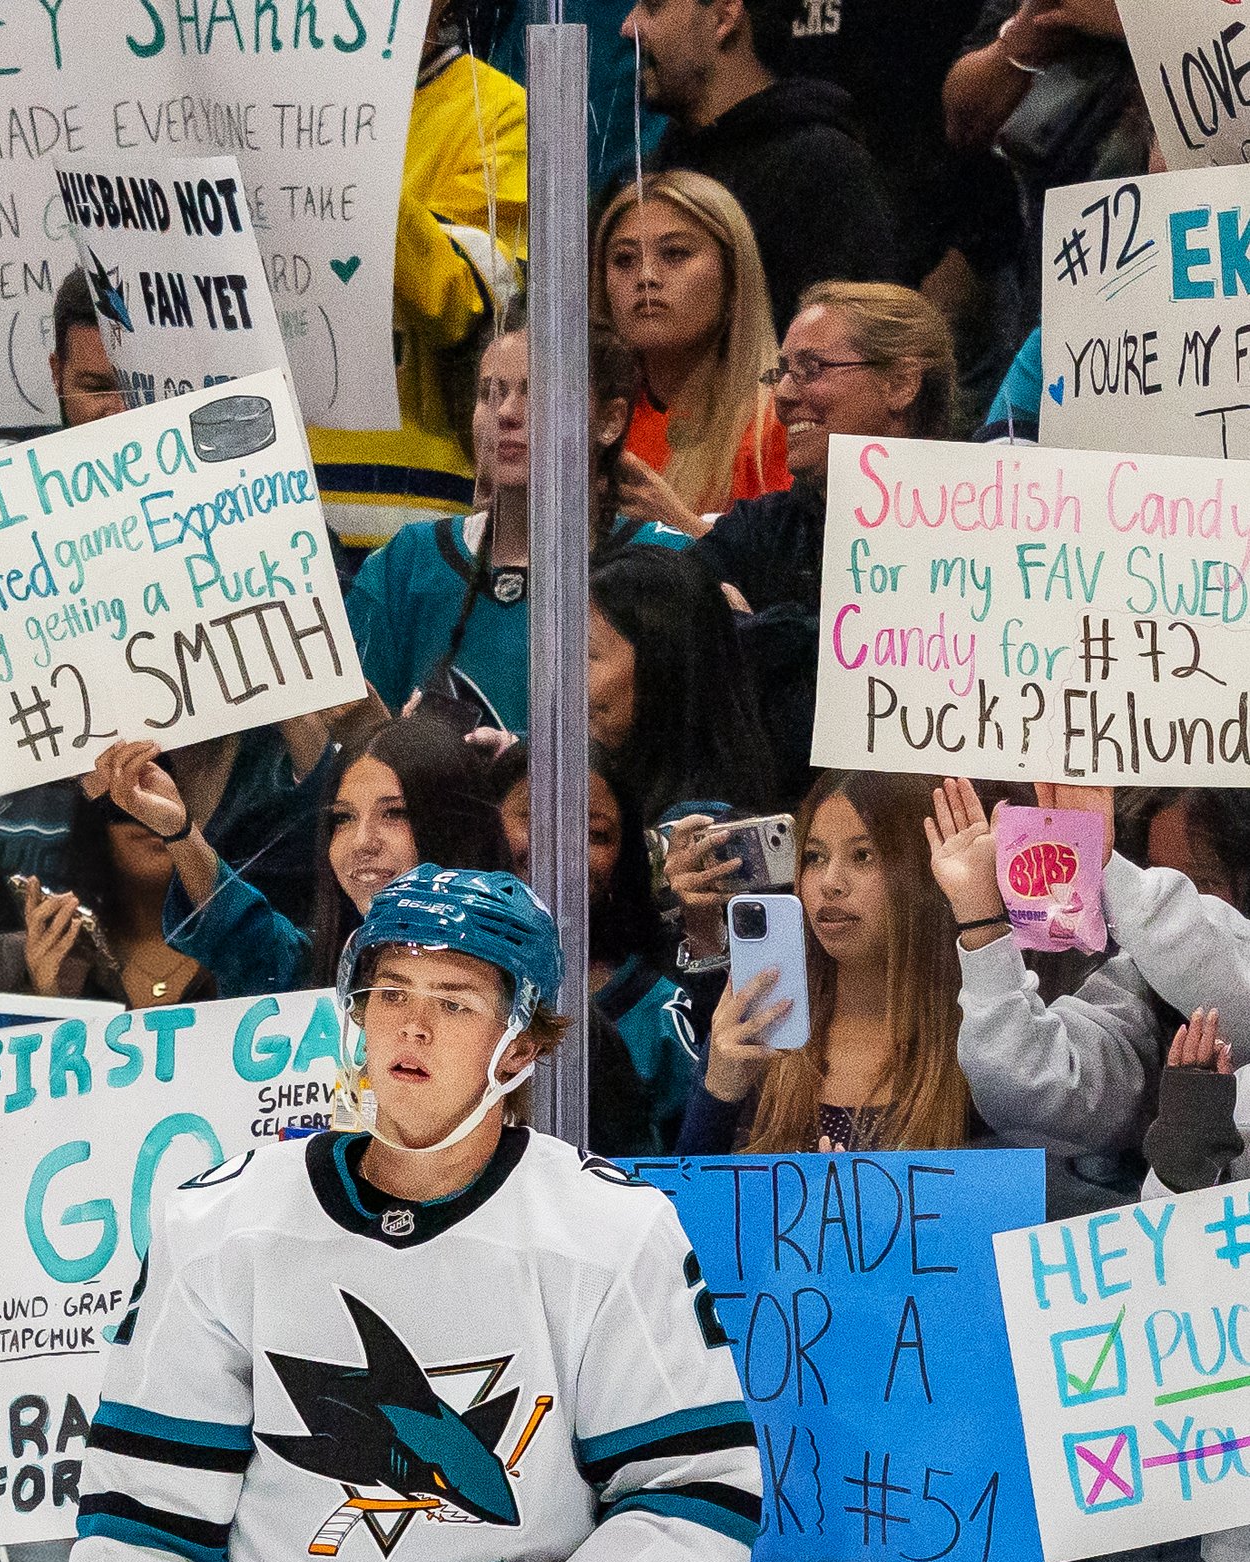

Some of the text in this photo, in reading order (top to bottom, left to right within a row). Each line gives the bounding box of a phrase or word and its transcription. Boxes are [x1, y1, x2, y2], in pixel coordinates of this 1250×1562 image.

[114, 95, 257, 152] EVERYONE
[273, 103, 379, 147] THEIR
[1159, 21, 1250, 149] LOVE
[55, 169, 171, 234] HUSBAND
[173, 177, 244, 238] NOT
[280, 185, 358, 224] TAKE
[1053, 182, 1156, 286] #72
[140, 271, 192, 328] FAN
[193, 273, 255, 331] YET
[1179, 325, 1222, 387] MY
[26, 438, 151, 517] have
[157, 425, 198, 478] a
[854, 442, 1250, 591] Swedish Candy
[54, 514, 146, 594] game
[140, 468, 316, 560] Experience
[846, 537, 909, 595] for
[930, 555, 992, 623] my
[1016, 542, 1106, 603] FAV
[25, 596, 129, 668] getting
[143, 581, 172, 616] a
[185, 530, 320, 610] Puck?
[9, 596, 343, 762] #2 SMITH
[832, 603, 977, 697] Candy
[999, 617, 1071, 681] for
[867, 675, 1250, 778] Puck? Eklund
[232, 996, 367, 1083] GA
[700, 1158, 959, 1283] TRADE
[1028, 1202, 1176, 1311] HEY
[63, 1289, 124, 1318] GRAF
[884, 1295, 934, 1404] A
